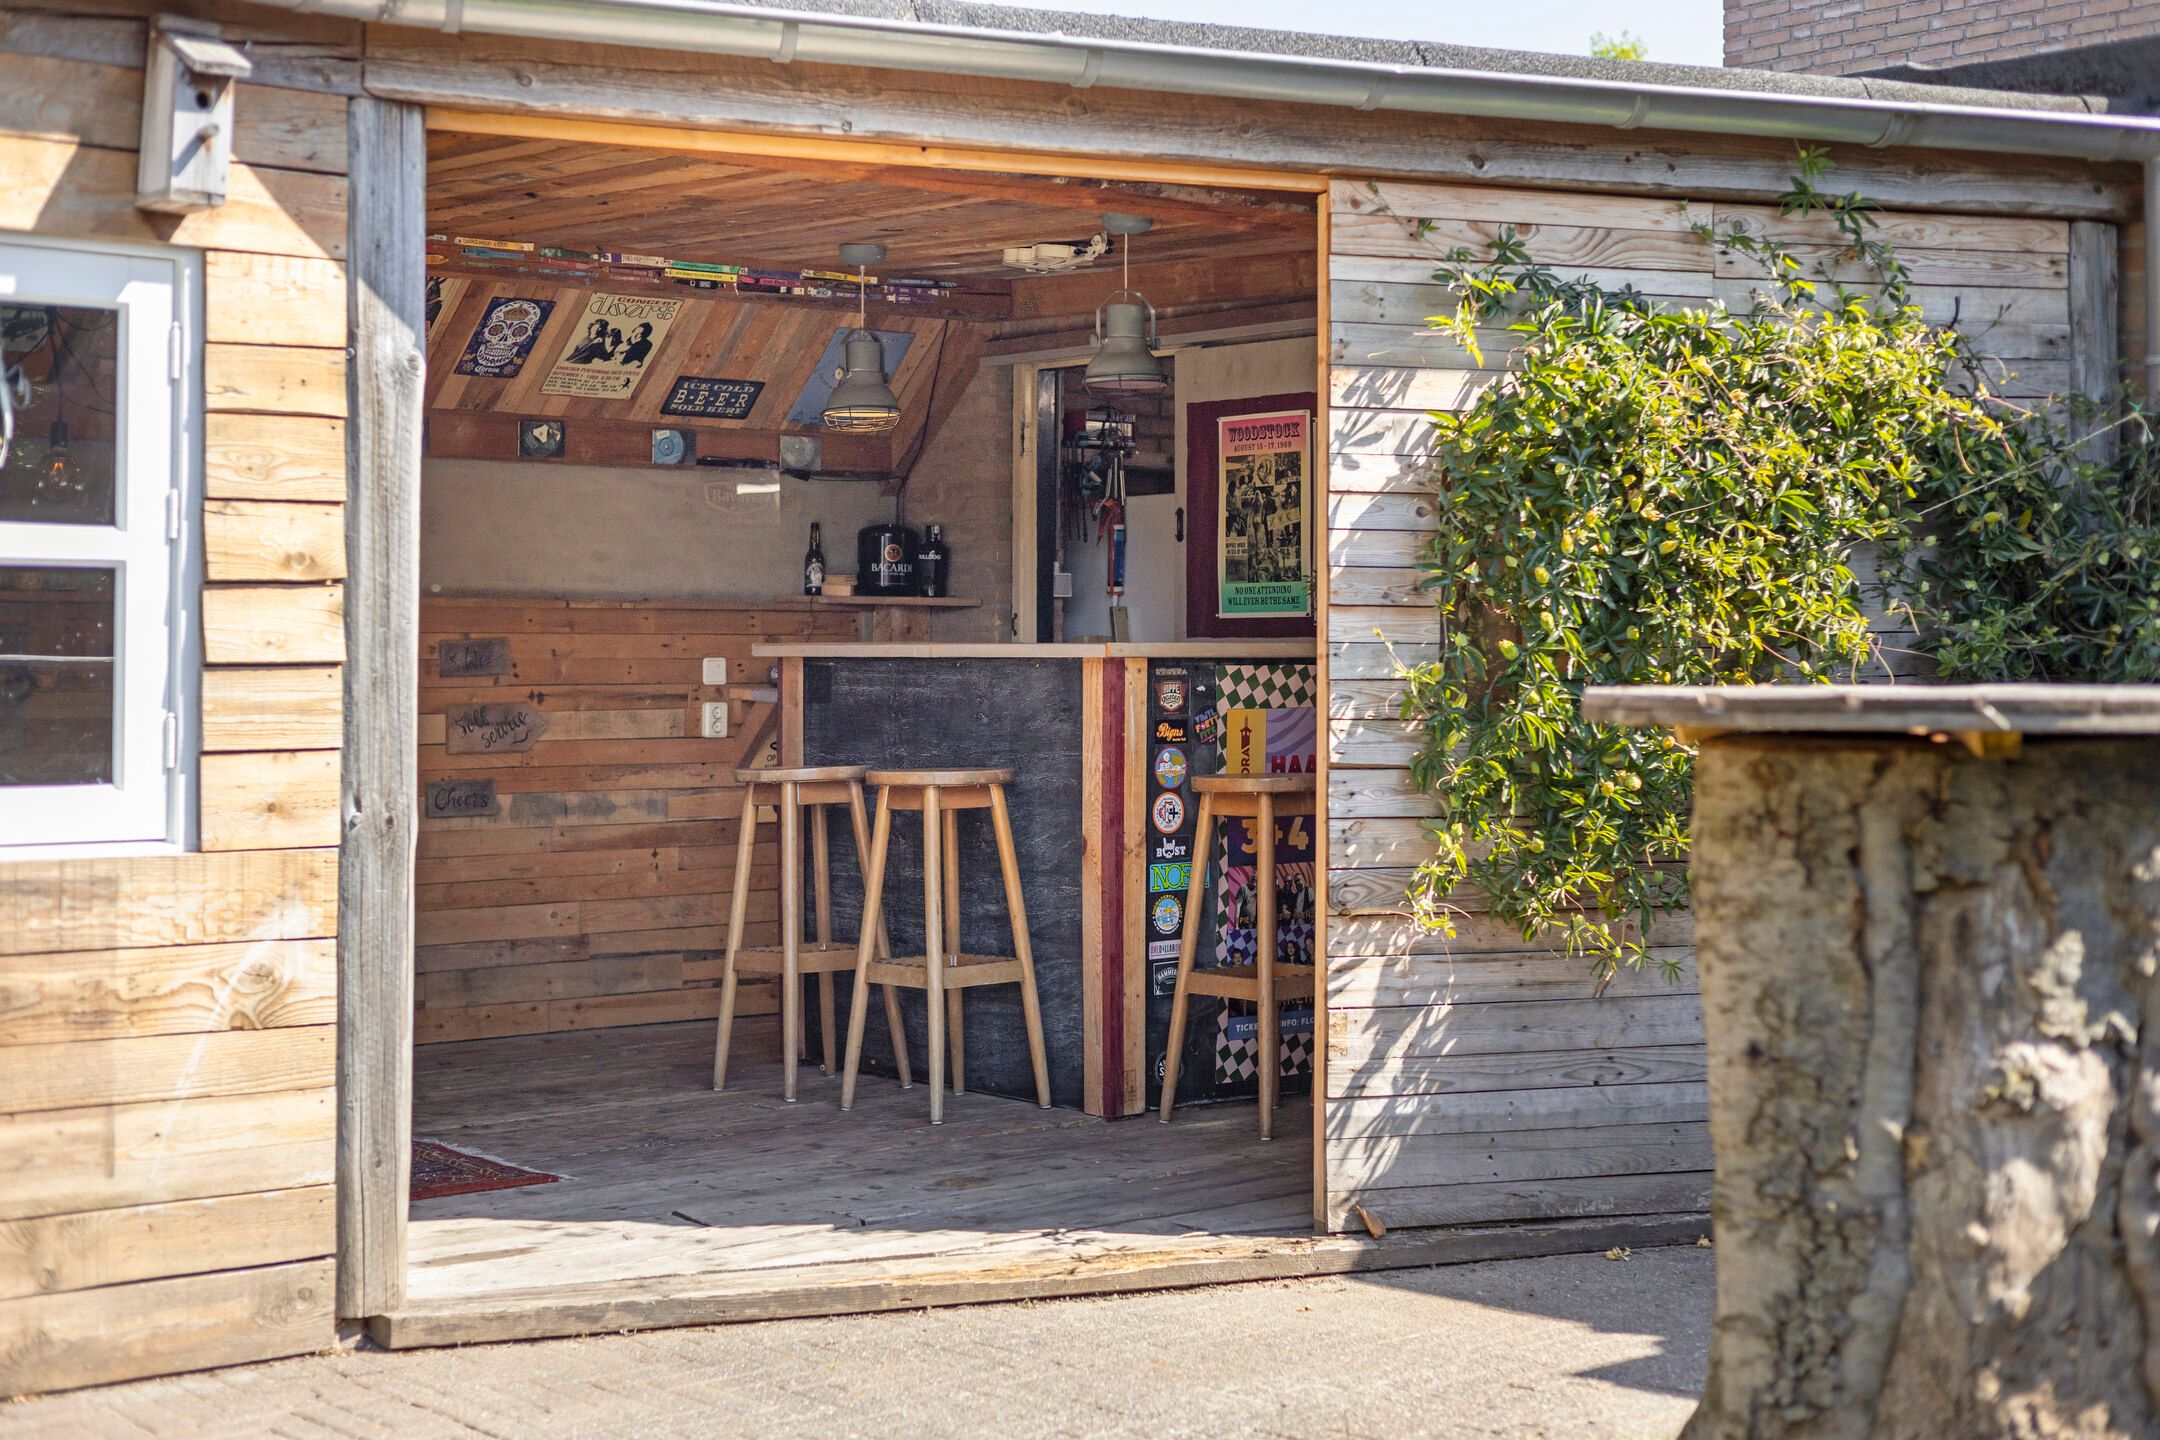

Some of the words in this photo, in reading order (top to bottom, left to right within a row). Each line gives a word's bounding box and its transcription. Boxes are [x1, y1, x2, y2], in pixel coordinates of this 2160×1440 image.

[683, 381, 711, 391] ICE
[713, 384, 755, 393] COLD
[670, 403, 705, 412] SOLD
[706, 405, 744, 415] HERE
[1228, 422, 1300, 442] WOODSTOCK
[1234, 443, 1256, 452] AUGUST
[1277, 440, 1292, 449] 1969
[871, 563, 913, 573] BACARDI
[1235, 586, 1243, 595] NO
[1244, 586, 1256, 595] ONE
[1257, 585, 1292, 595] ATTENDING
[1227, 597, 1244, 606] WILL
[1244, 597, 1260, 606] EVER
[1260, 597, 1269, 605] BE
[1269, 597, 1281, 605] THE
[1282, 596, 1301, 605] SAME
[1271, 754, 1316, 773] HAA
[435, 788, 488, 810] Cheers
[1152, 863, 1200, 891] NOF
[1236, 1022, 1259, 1032] TICKE
[1281, 1018, 1299, 1028] NFO:
